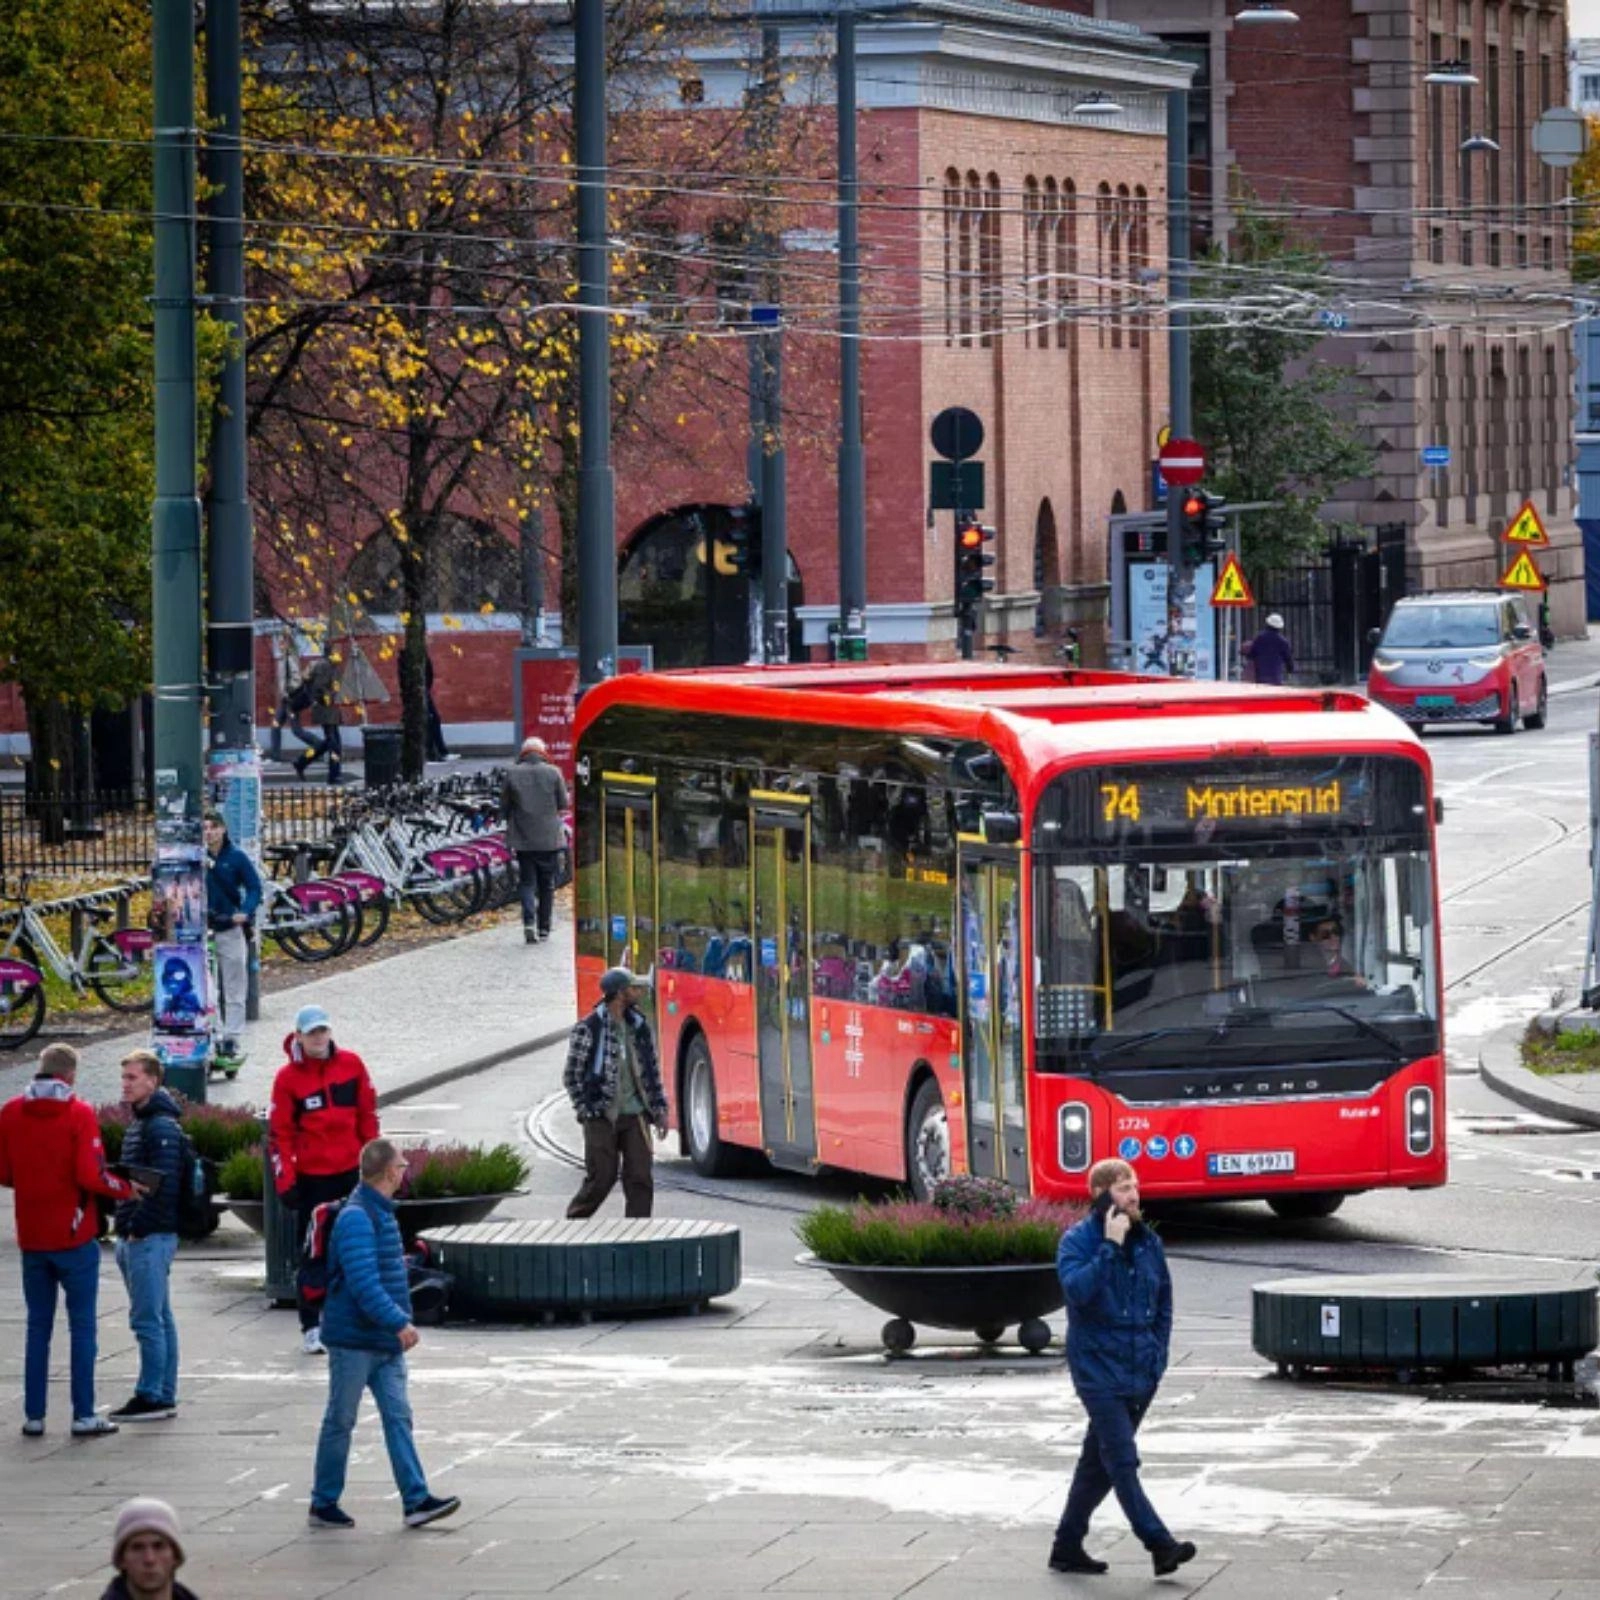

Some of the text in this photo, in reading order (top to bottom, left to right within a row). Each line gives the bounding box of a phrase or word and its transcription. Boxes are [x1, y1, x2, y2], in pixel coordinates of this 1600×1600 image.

[1101, 779, 1340, 821] 74 Mortensrud
[1118, 1116, 1150, 1130] 1724
[1222, 1156, 1241, 1170] EN
